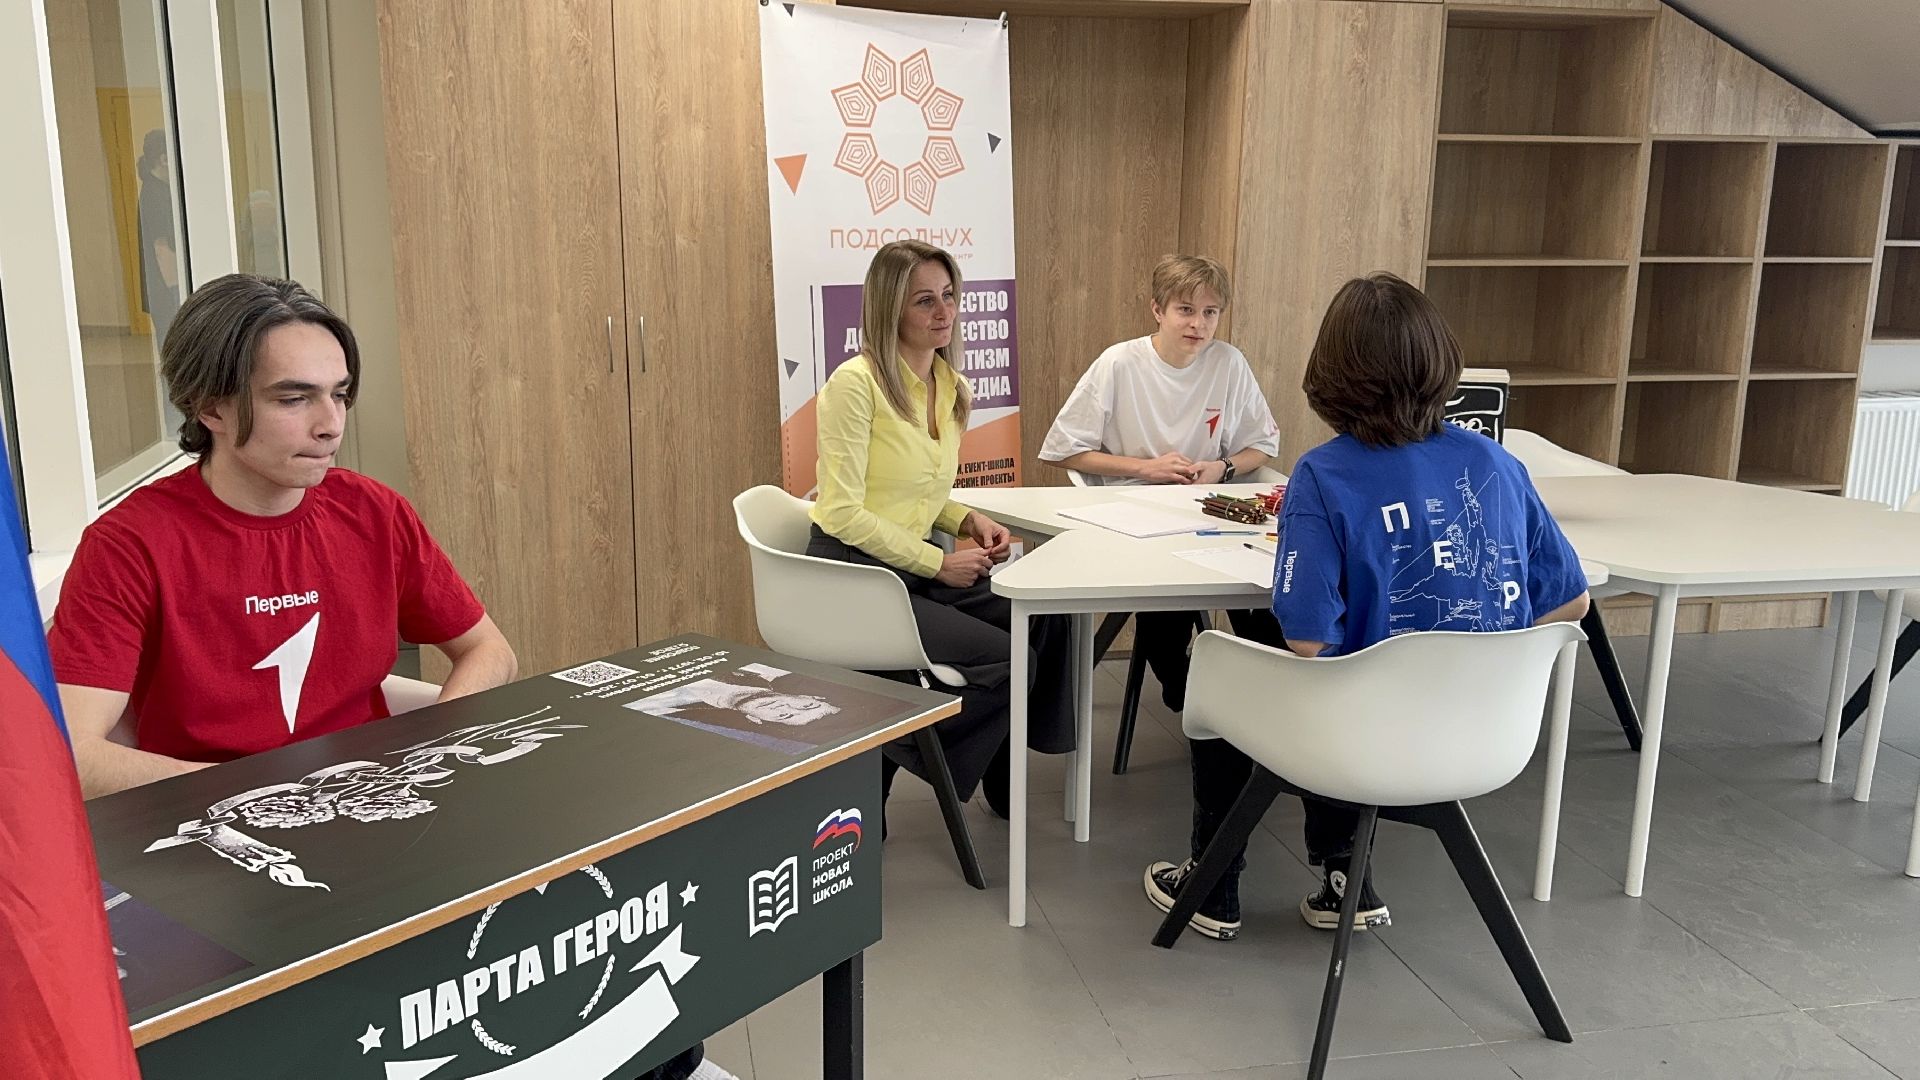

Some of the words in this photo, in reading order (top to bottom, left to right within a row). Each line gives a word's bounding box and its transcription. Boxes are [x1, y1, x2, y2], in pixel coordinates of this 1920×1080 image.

[959, 290, 1008, 313] ЕСТВО
[960, 318, 1009, 342] ЕСТВО
[970, 375, 1012, 401] ЕДИА
[952, 476, 980, 488] ЕРСКИЕ
[980, 471, 1015, 487] ПРОЕКТЫ
[1381, 502, 1410, 533] П
[1282, 550, 1298, 593] Первые
[245, 590, 319, 616] Первые
[1503, 580, 1521, 610] Р
[813, 842, 854, 872] ПРОЕКТ
[812, 860, 850, 889] НОВАЯ
[812, 876, 854, 905] ШКОЛА
[400, 945, 545, 1049] ПАРТА
[553, 881, 669, 975] ГЕРОЯ
